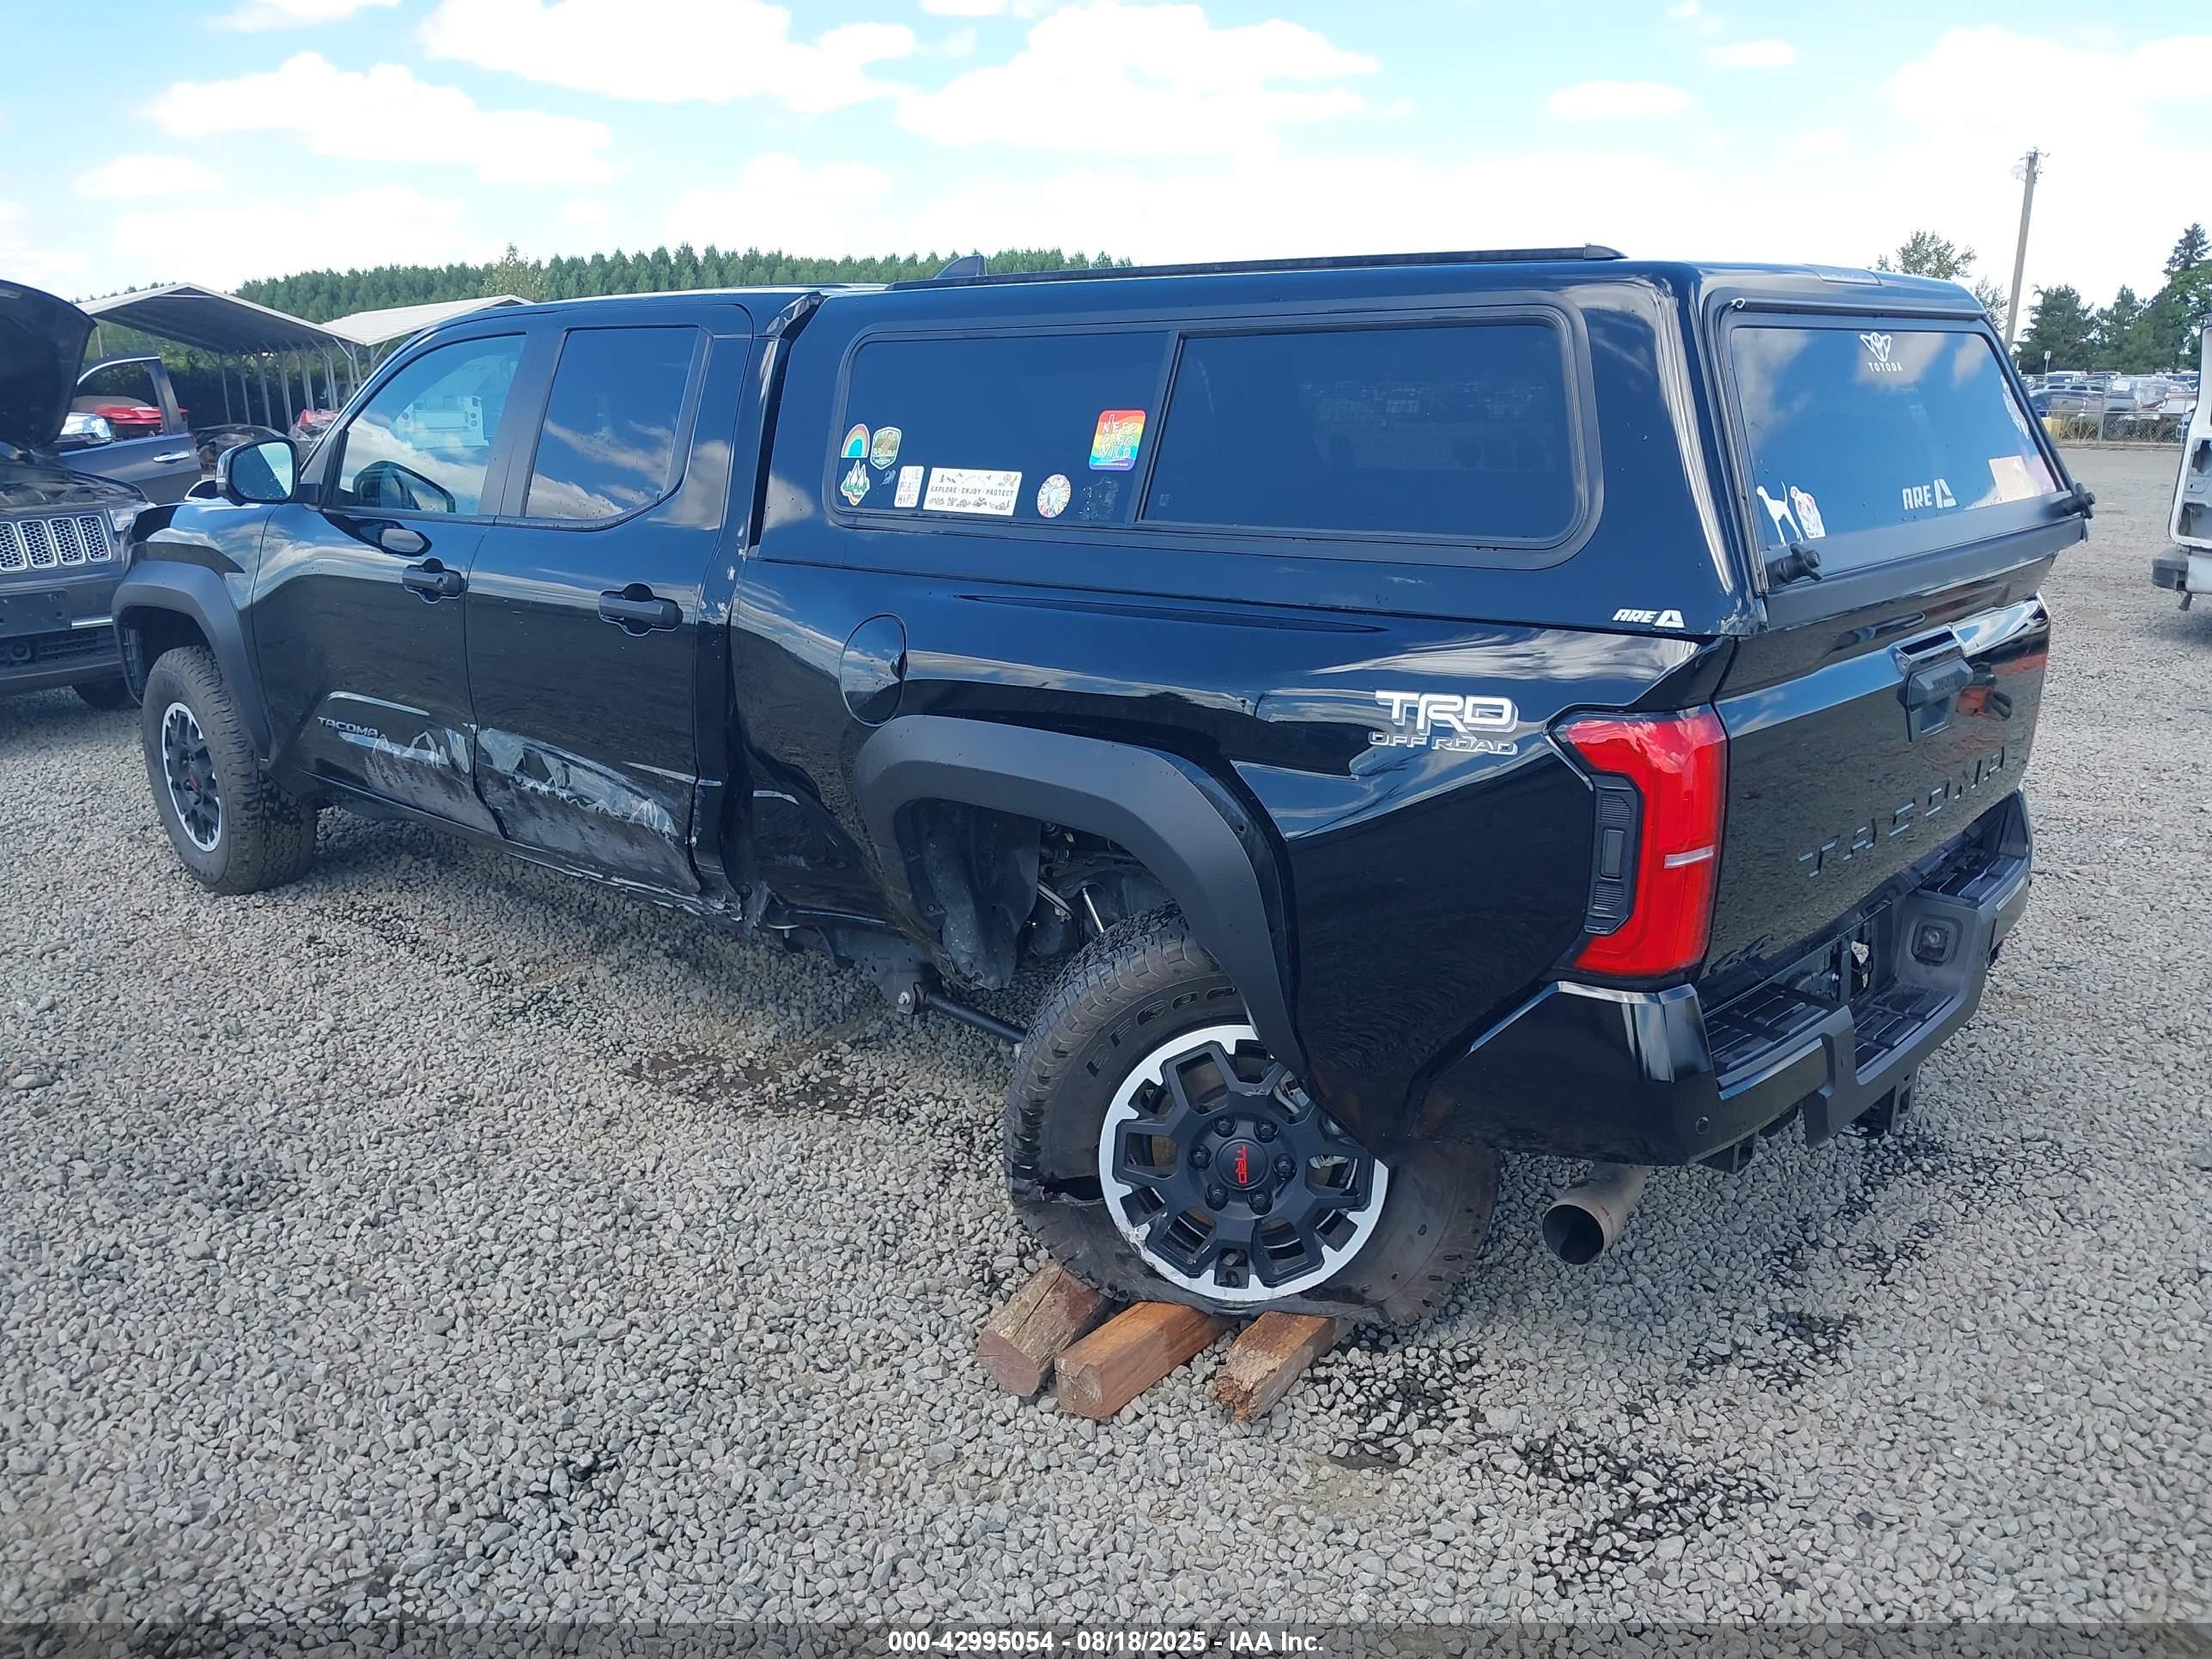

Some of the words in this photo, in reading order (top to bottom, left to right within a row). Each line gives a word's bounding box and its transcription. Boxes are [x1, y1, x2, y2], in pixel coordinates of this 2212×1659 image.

[1868, 362, 1904, 372] TOYODA
[1102, 422, 1138, 435] KEEP
[1099, 433, 1134, 446] IDAHO
[1097, 445, 1132, 460] WILD
[930, 485, 957, 495] EXPLORE
[961, 487, 981, 495] ENJOY
[985, 489, 1016, 498] PROTECT
[1375, 690, 1519, 738] TRD
[317, 716, 379, 738] TACOMA
[1368, 731, 1428, 749] OFF
[1431, 734, 1518, 757] ROAD
[1798, 744, 2007, 878] TACOMA
[1234, 1144, 1249, 1184] TRD
